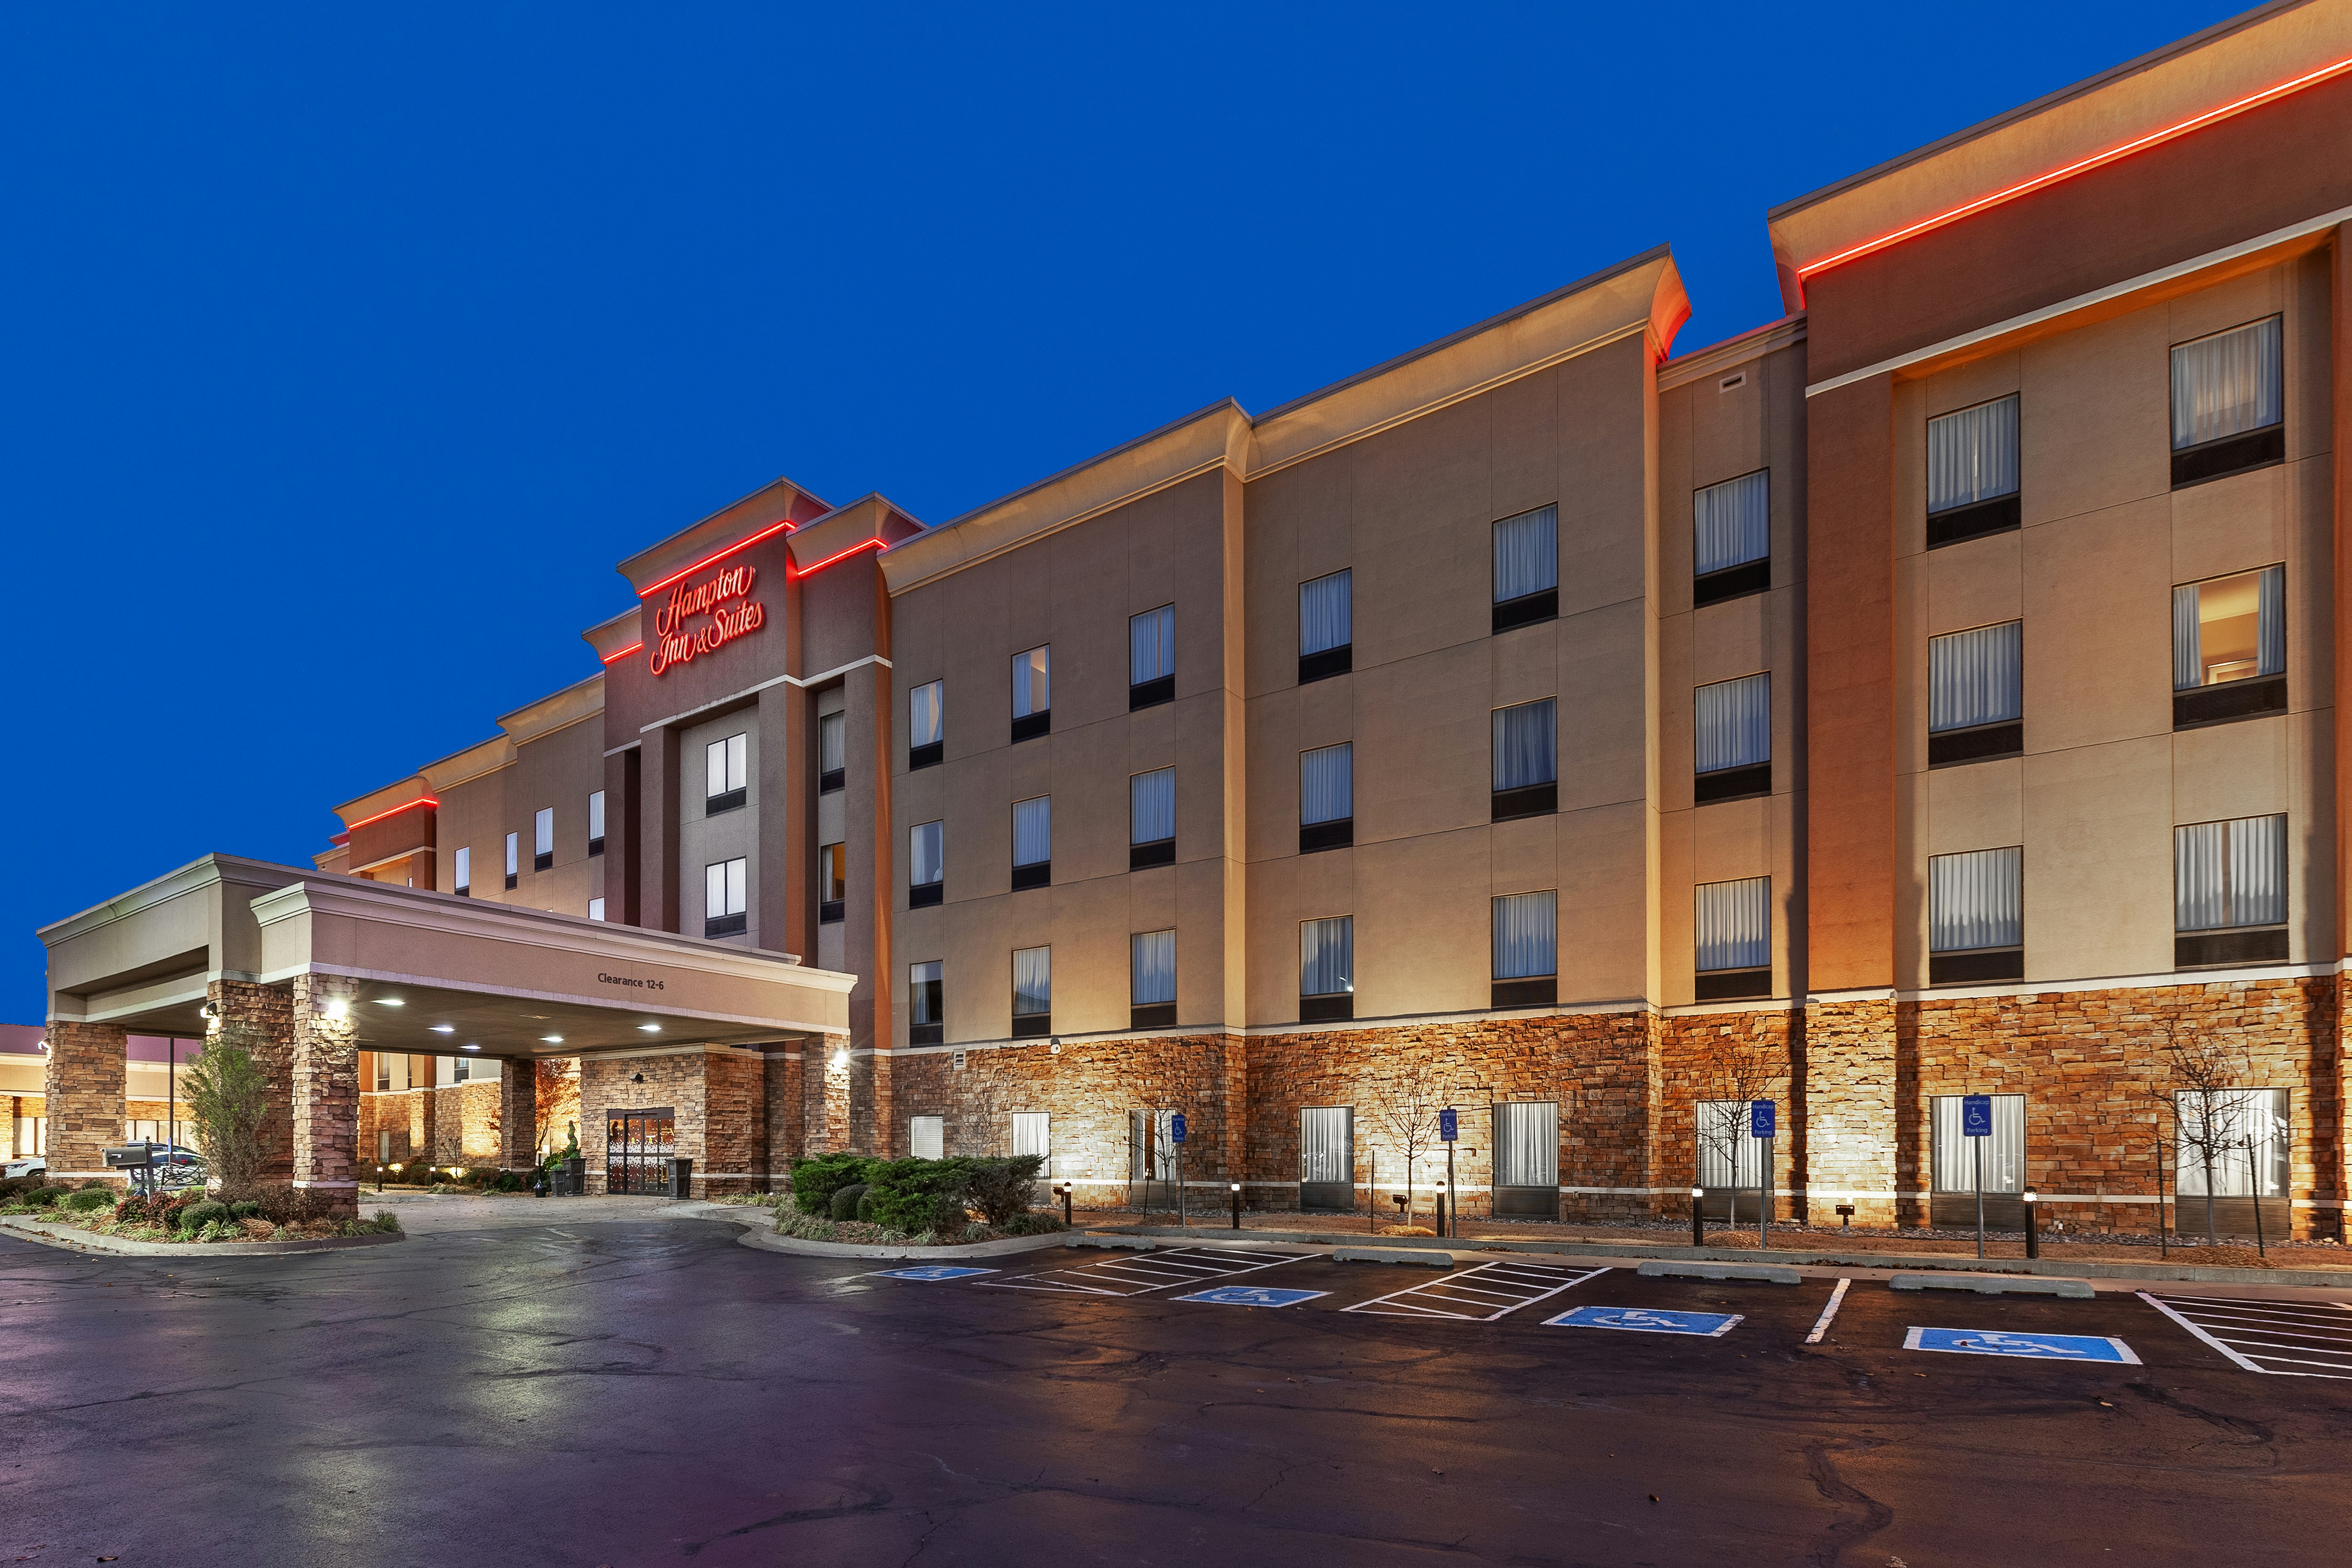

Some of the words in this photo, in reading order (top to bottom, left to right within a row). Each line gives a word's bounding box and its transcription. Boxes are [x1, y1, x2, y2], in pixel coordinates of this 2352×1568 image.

[656, 565, 755, 637] Hampton
[650, 632, 697, 676] Inn
[697, 627, 710, 653] &
[708, 599, 764, 648] Suites
[597, 973, 643, 987] Clearance
[646, 979, 664, 990] 12-6
